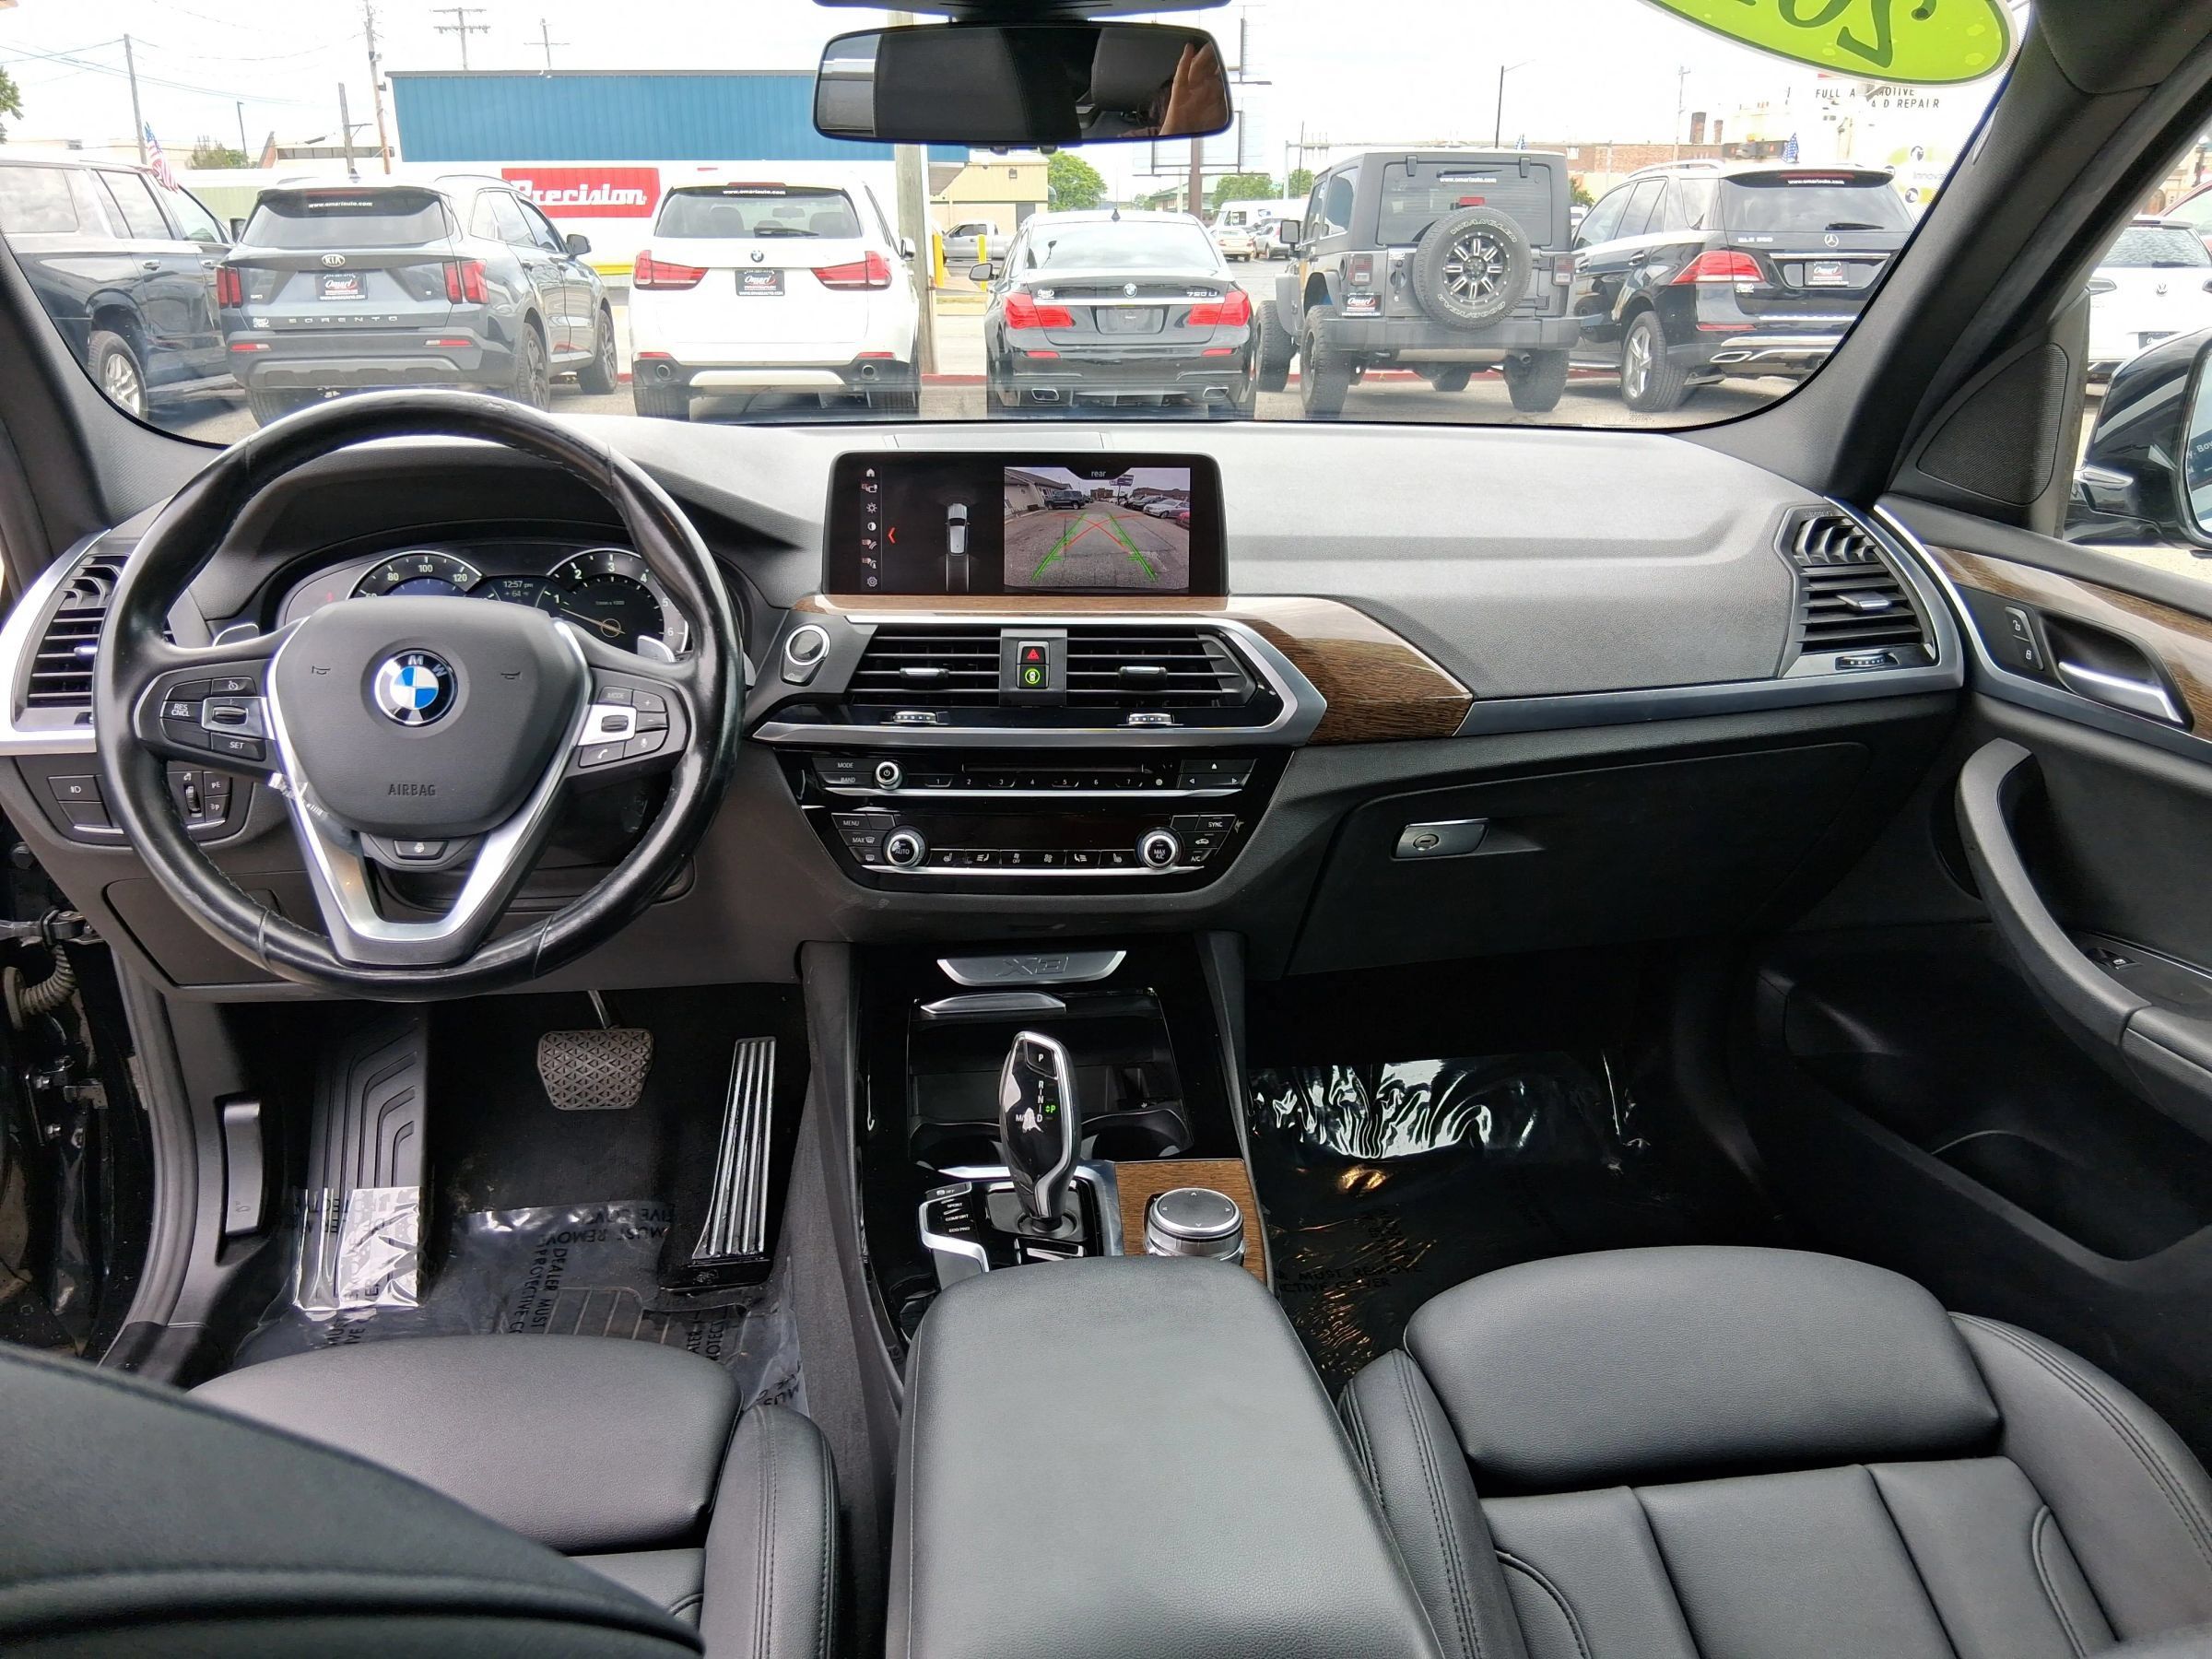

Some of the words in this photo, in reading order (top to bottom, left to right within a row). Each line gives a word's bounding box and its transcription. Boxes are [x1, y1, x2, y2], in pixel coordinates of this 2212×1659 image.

[1816, 88, 1841, 99] FULL
[1897, 99, 1939, 109] REPAIR
[324, 255, 343, 265] KIA
[288, 315, 398, 324] SORENTO
[1090, 470, 1106, 478] rear
[418, 564, 433, 573] 100
[608, 561, 616, 572] 3
[387, 572, 400, 582] 80
[453, 573, 467, 582] 120
[574, 569, 582, 580] 2
[639, 573, 648, 583] 4
[553, 594, 560, 604] 1
[662, 599, 669, 607] 5
[666, 627, 675, 636] 6
[171, 709, 190, 717] CNCL
[229, 741, 245, 749] SET
[388, 783, 436, 796] AIRBAG
[1038, 1053, 1044, 1063] P
[1038, 1080, 1044, 1088] R
[1037, 1095, 1044, 1104] N
[1050, 1104, 1056, 1113] P
[1036, 1113, 1043, 1123] D
[945, 1214, 969, 1222] COMFORT
[544, 1248, 568, 1291] DEALER
[530, 1298, 553, 1328] MUST
